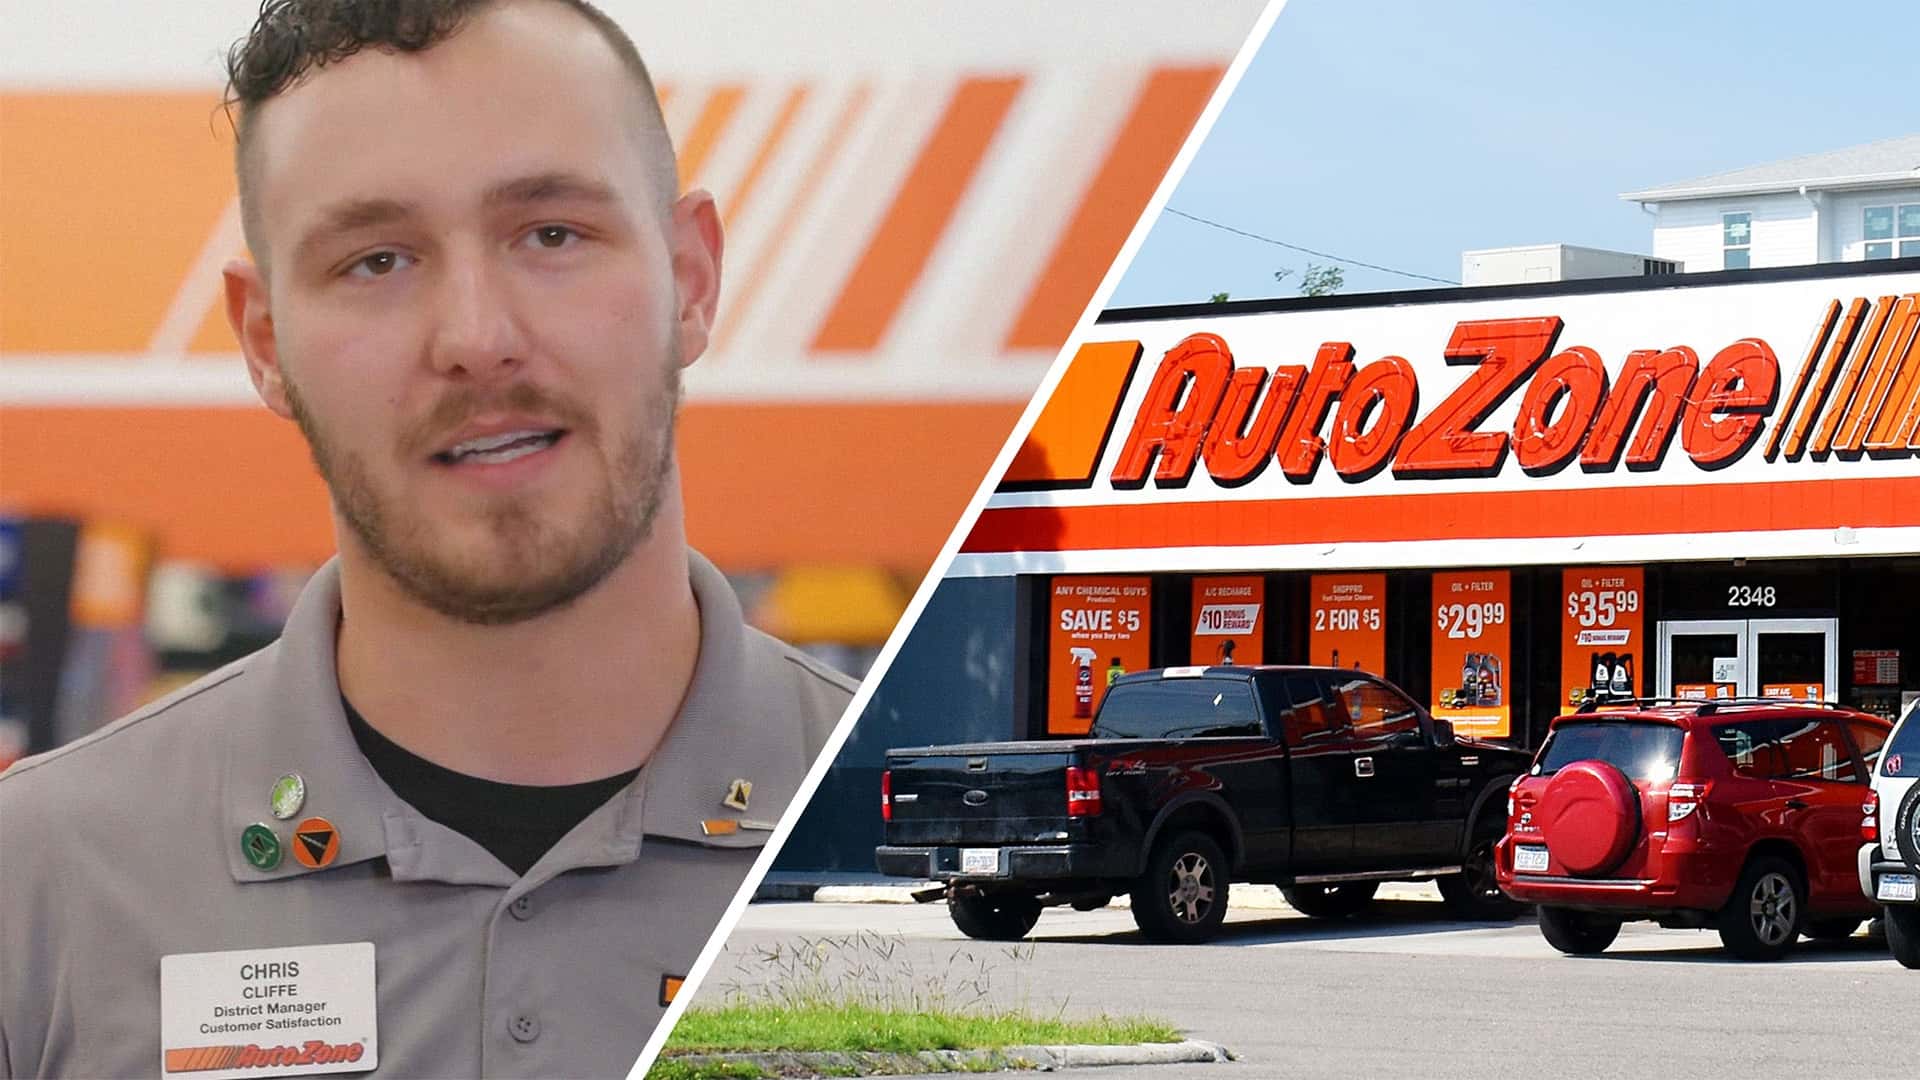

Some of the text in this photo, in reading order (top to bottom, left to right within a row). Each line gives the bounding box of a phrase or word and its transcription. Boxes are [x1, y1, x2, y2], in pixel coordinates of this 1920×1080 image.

[1110, 315, 1781, 490] AutoZone
[1055, 586, 1148, 596] ANY CHEMICAL GUYS
[1471, 581, 1494, 592] FILTER
[1601, 578, 1625, 588] FILTER
[1728, 585, 1776, 607] 2348
[1061, 609, 1140, 631] SAVE $5
[1201, 610, 1222, 630] $10
[1315, 608, 1380, 631] 2 FOR $5
[240, 961, 300, 981] CHRIS
[242, 984, 298, 1000] CLIFFE
[213, 1001, 327, 1018] District Manager
[199, 1016, 342, 1034] Customer Satisfaction
[235, 1040, 365, 1069] AutoZone
